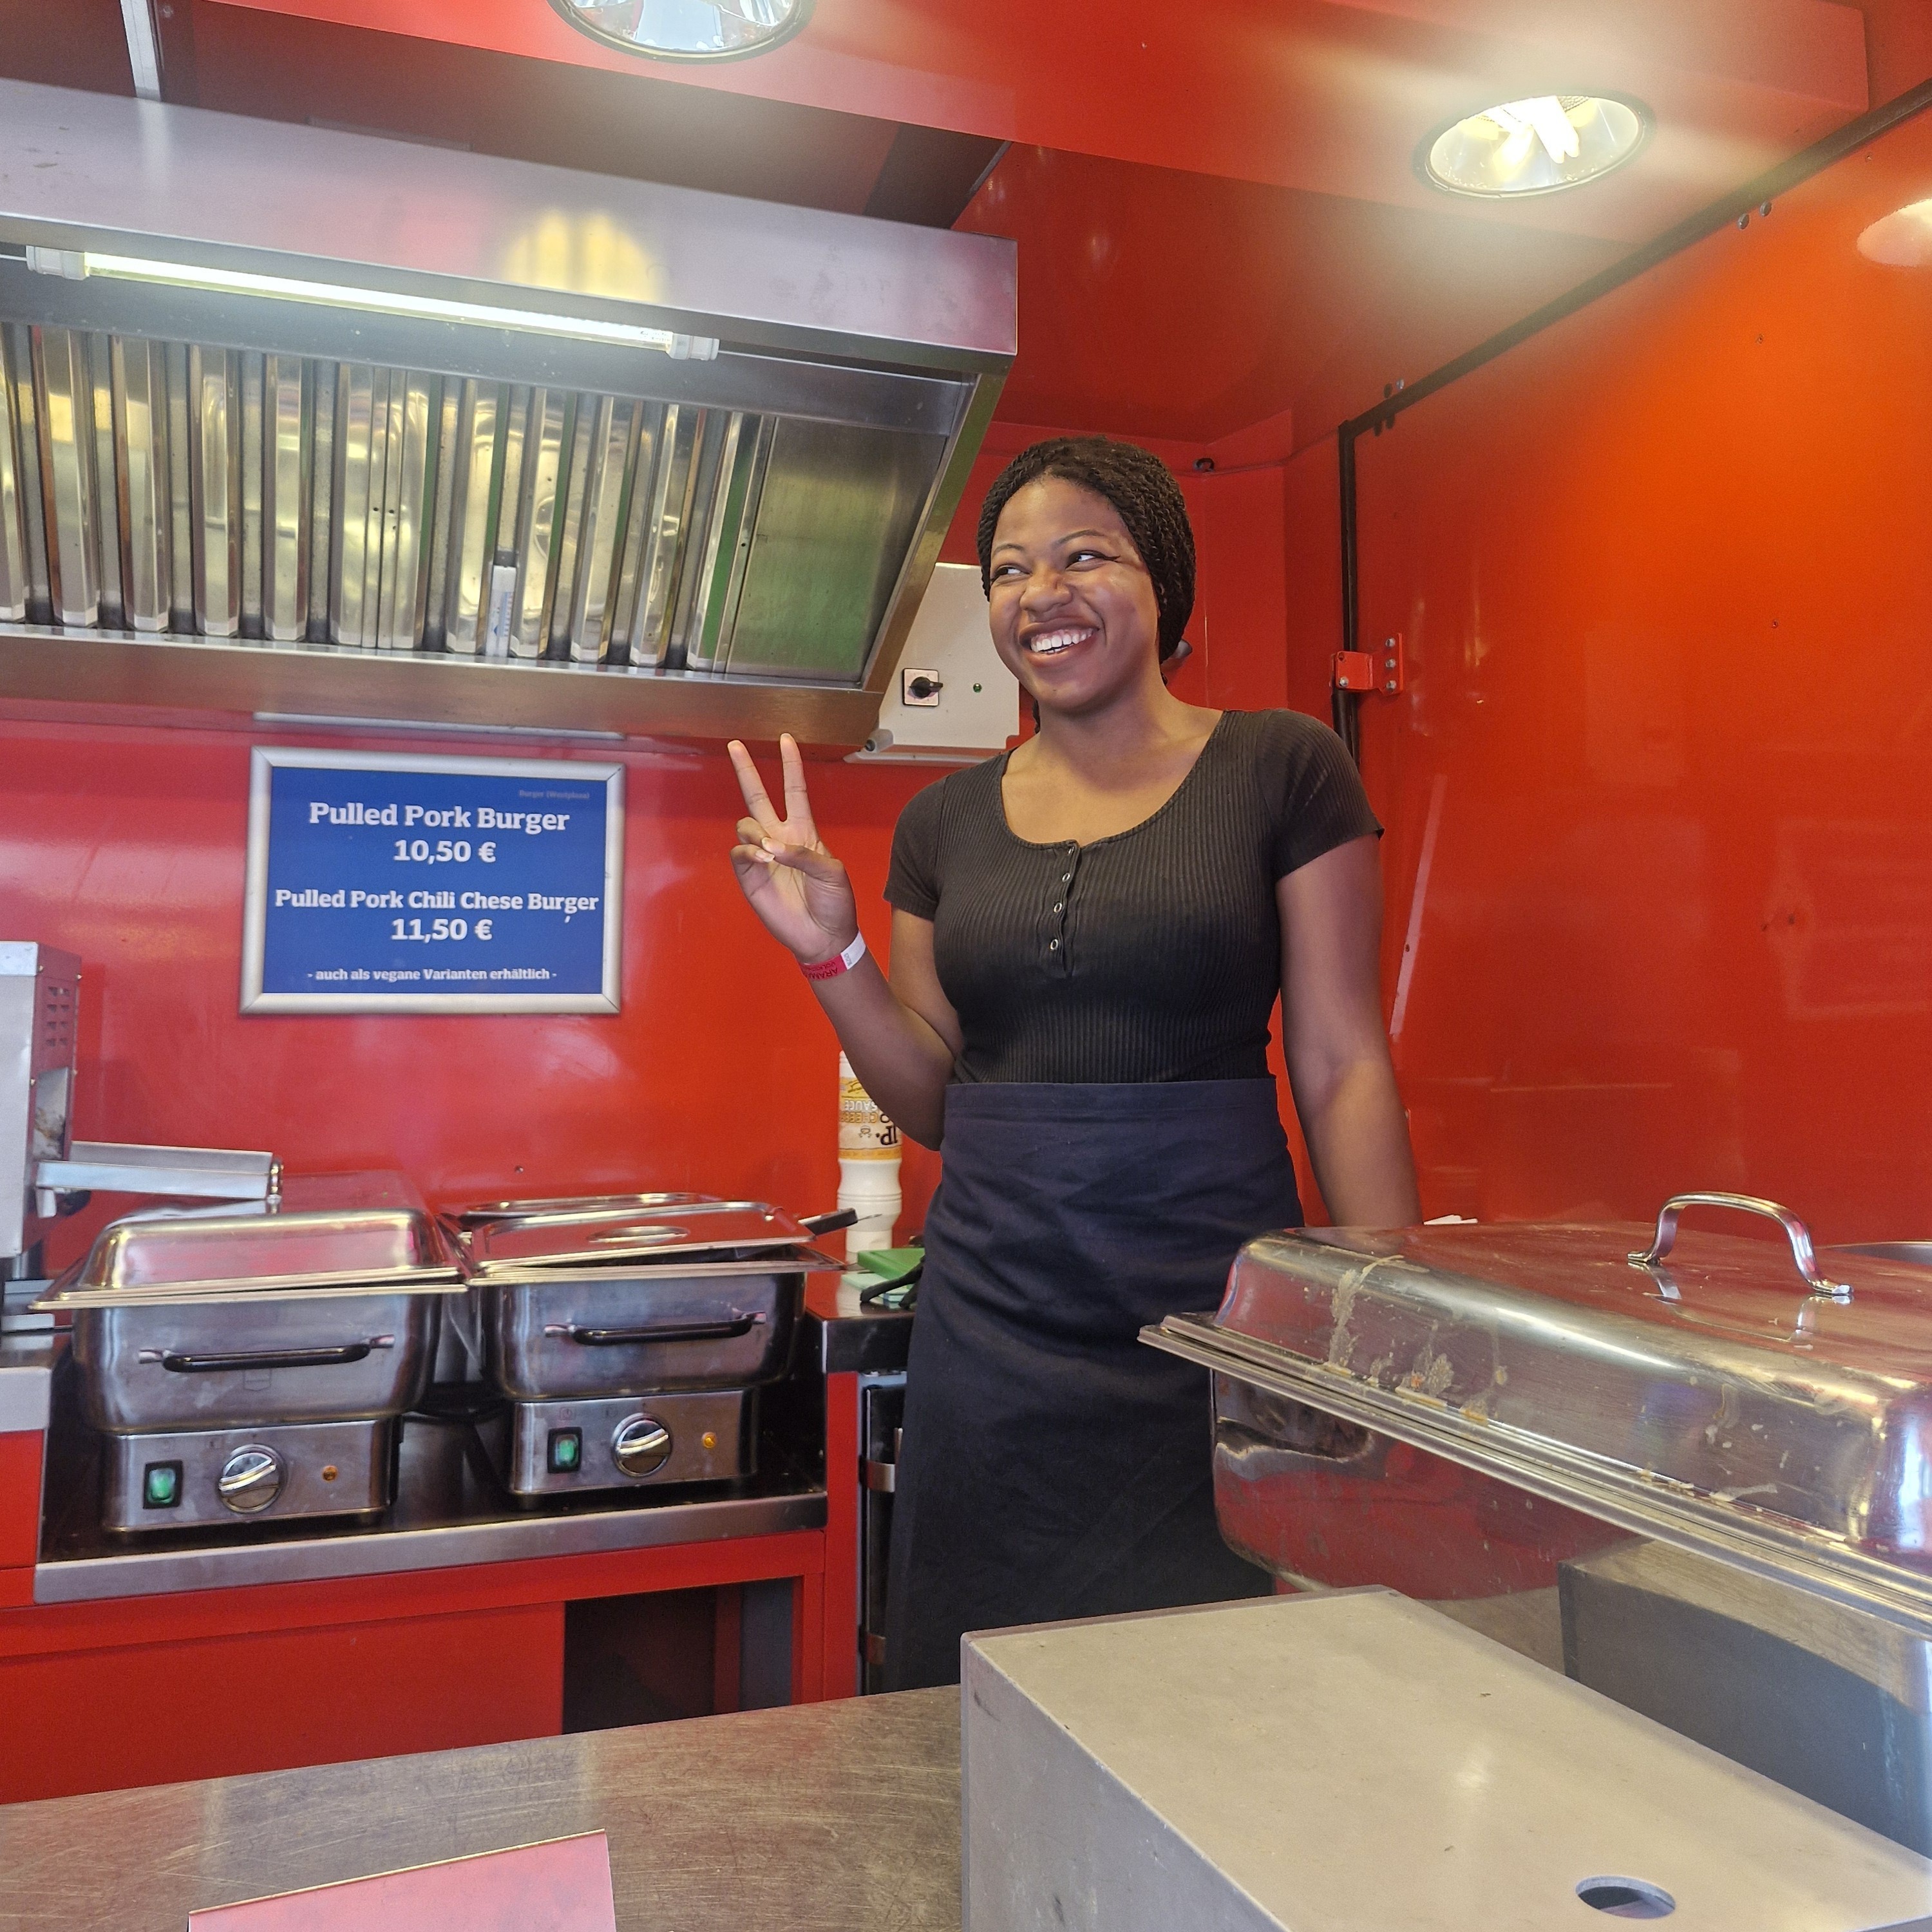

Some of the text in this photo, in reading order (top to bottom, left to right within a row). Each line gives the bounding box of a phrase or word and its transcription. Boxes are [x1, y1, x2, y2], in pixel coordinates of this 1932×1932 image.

[309, 802, 570, 835] Pulled Pork Burger
[393, 840, 496, 864] 10,50 €
[275, 889, 599, 914] Pulled Pork Chili Chese Burger
[391, 918, 493, 943] 11,50 €
[316, 969, 348, 981] auch
[350, 969, 370, 980] als
[373, 971, 421, 983] vegane
[423, 969, 488, 980] Varianten
[489, 968, 550, 980] erhältlich
[844, 1099, 878, 1112] SAUCE
